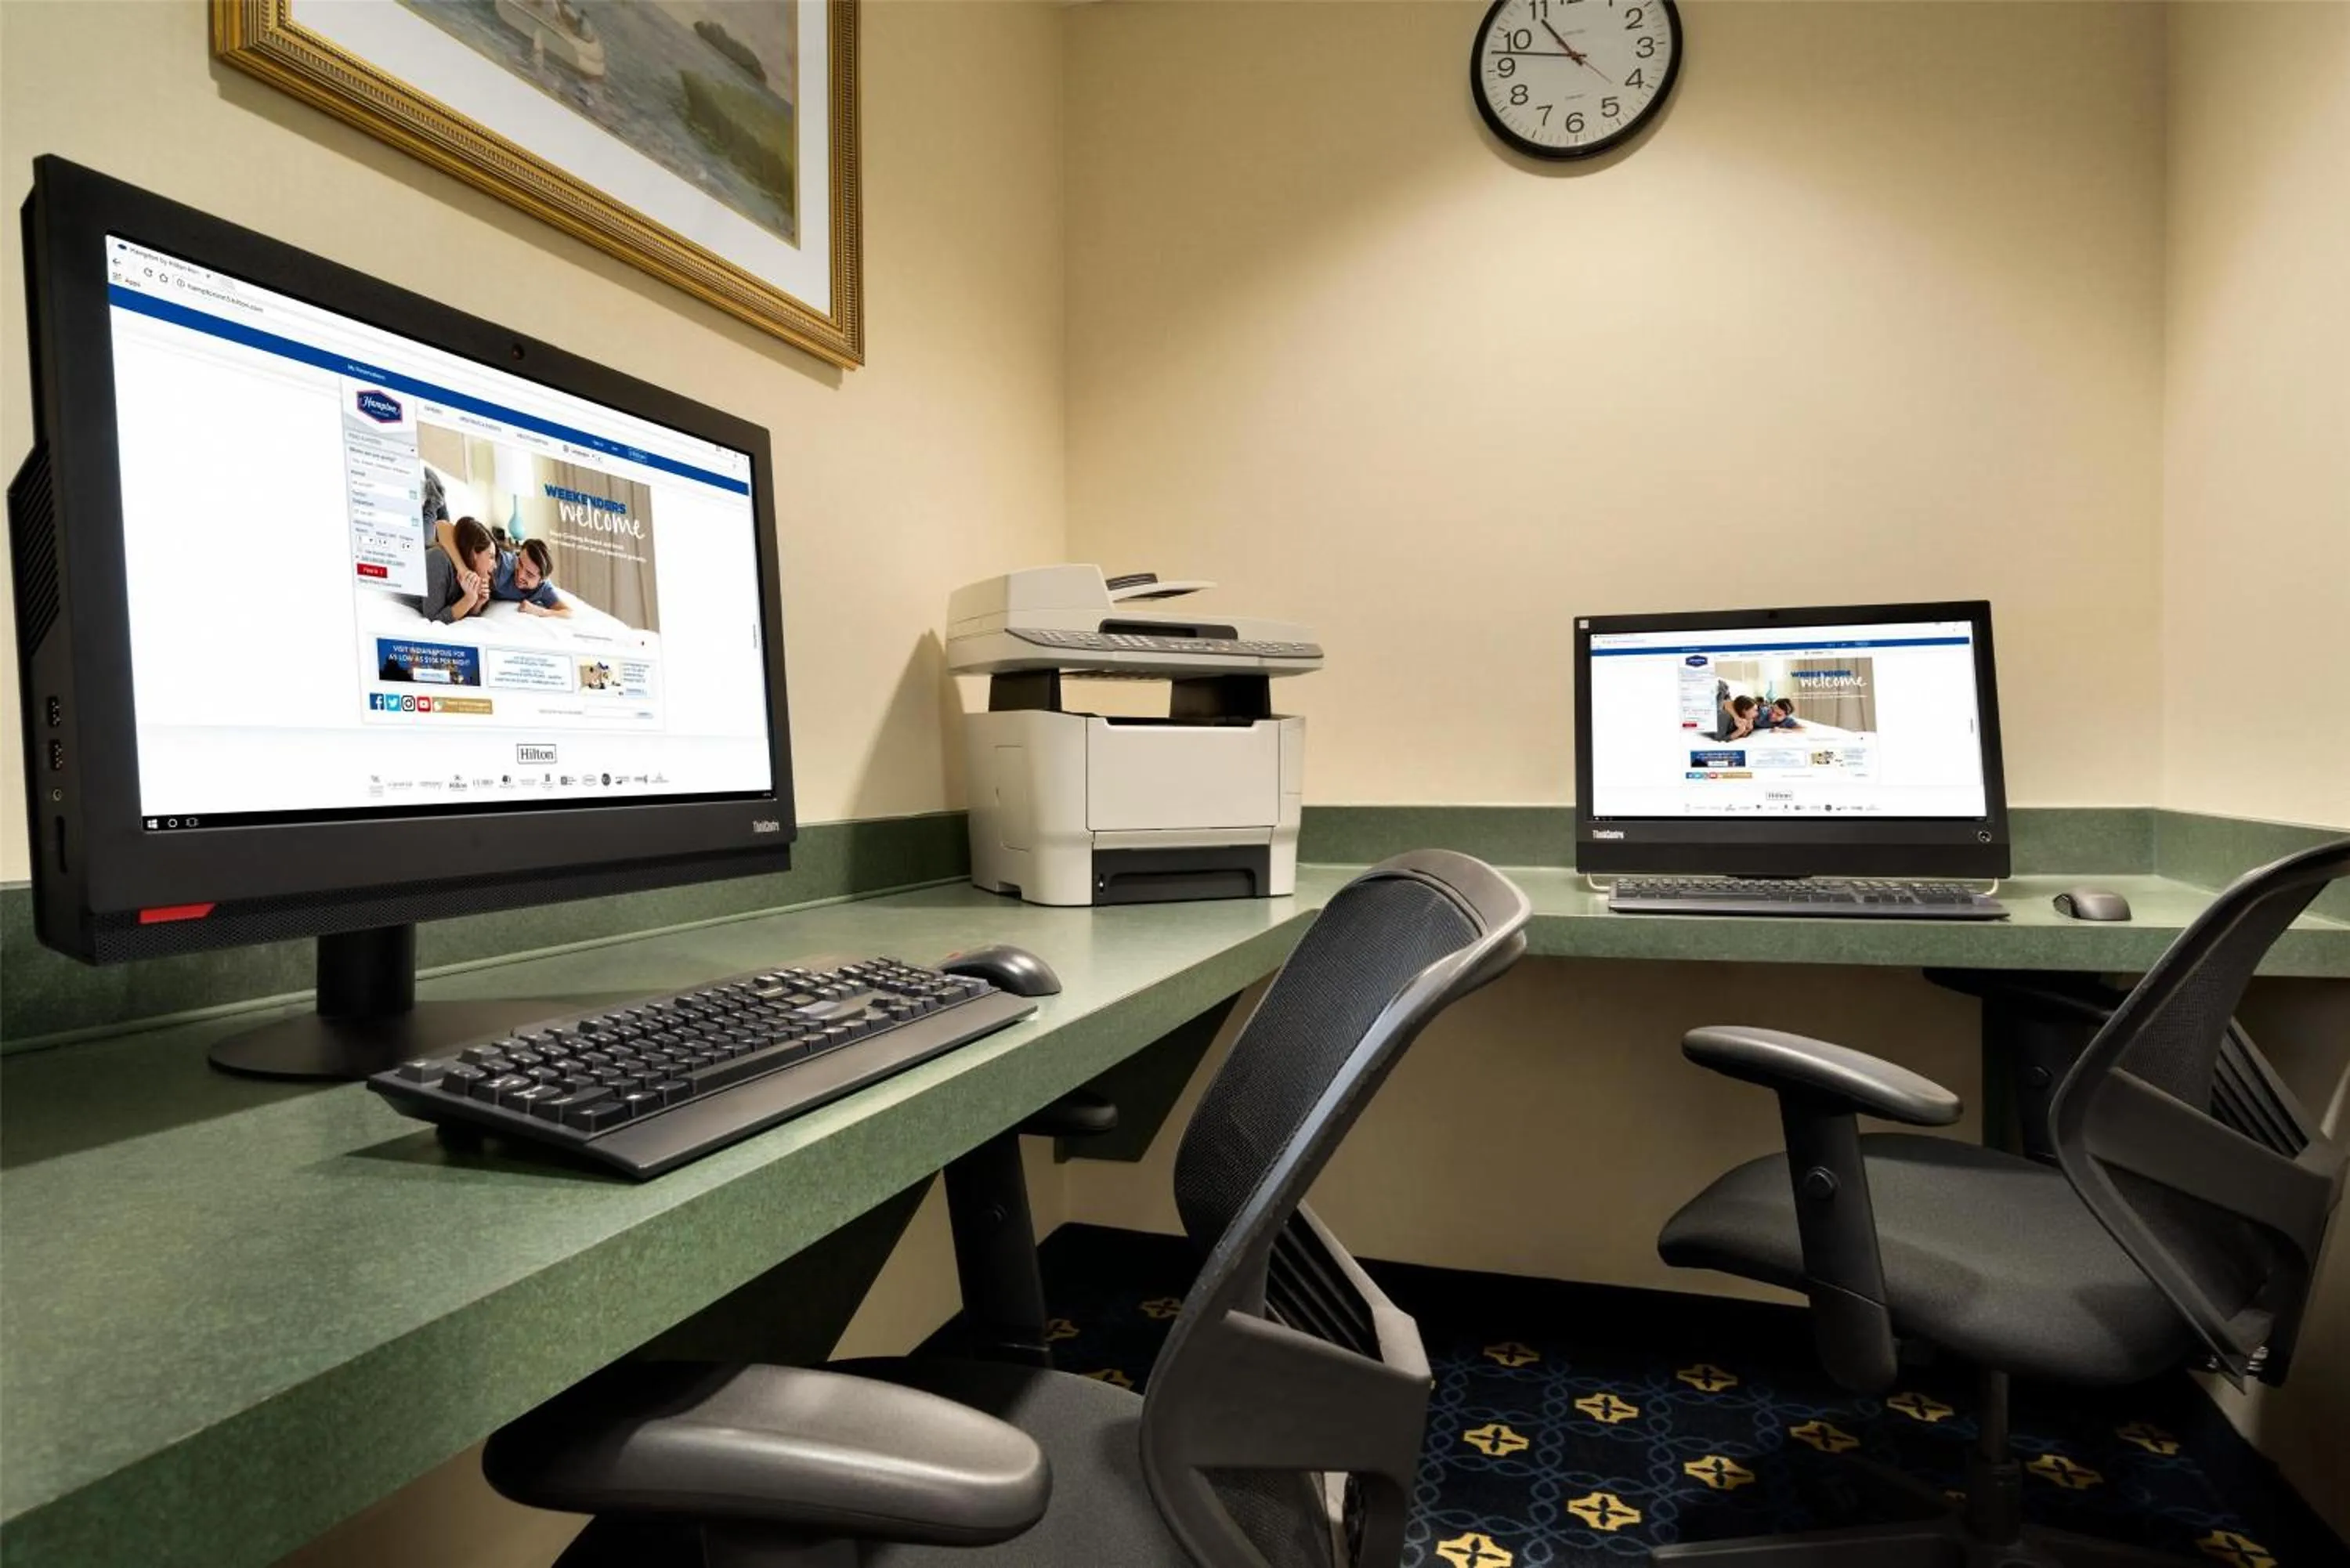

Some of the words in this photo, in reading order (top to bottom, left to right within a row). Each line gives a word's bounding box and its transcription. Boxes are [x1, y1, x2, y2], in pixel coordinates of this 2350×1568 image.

[1529, 0, 1548, 20] 11
[1625, 8, 1644, 30] 2
[1503, 29, 1531, 52] 10
[1636, 37, 1655, 58] 3
[1497, 57, 1516, 78] 9
[1625, 68, 1644, 89] 4
[1510, 84, 1528, 105] 8
[1536, 104, 1553, 126] 7
[1602, 96, 1620, 117] 5
[1567, 112, 1585, 133] 6
[363, 395, 397, 414] Hampton
[544, 482, 627, 515] WEEKENDERS
[559, 498, 646, 540] welcome
[1799, 674, 1867, 688] welcome
[520, 747, 554, 761] Hilton
